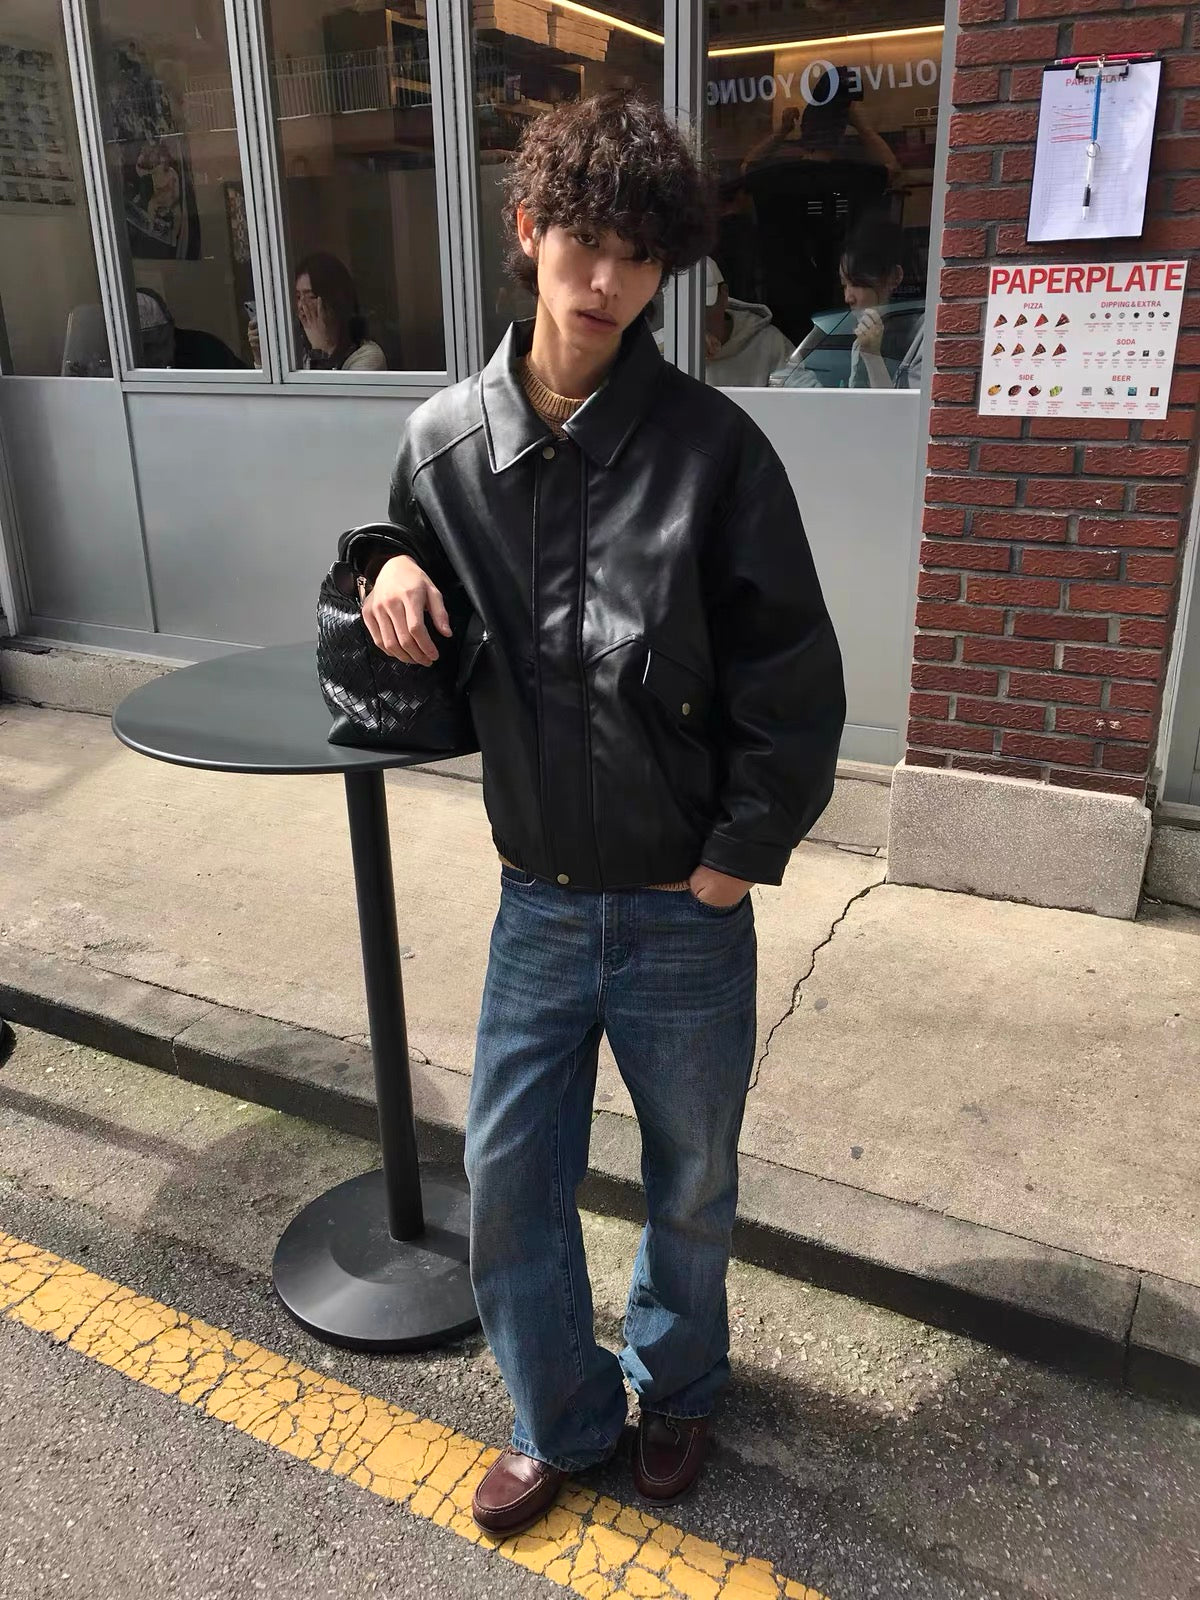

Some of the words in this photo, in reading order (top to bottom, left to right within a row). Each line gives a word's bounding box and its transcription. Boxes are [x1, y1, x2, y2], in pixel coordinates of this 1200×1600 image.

[1065, 76, 1095, 86] PAPER
[991, 264, 1185, 295] PAPERPLATE
[1023, 302, 1043, 310] PIZZA
[1116, 338, 1136, 346] SODA
